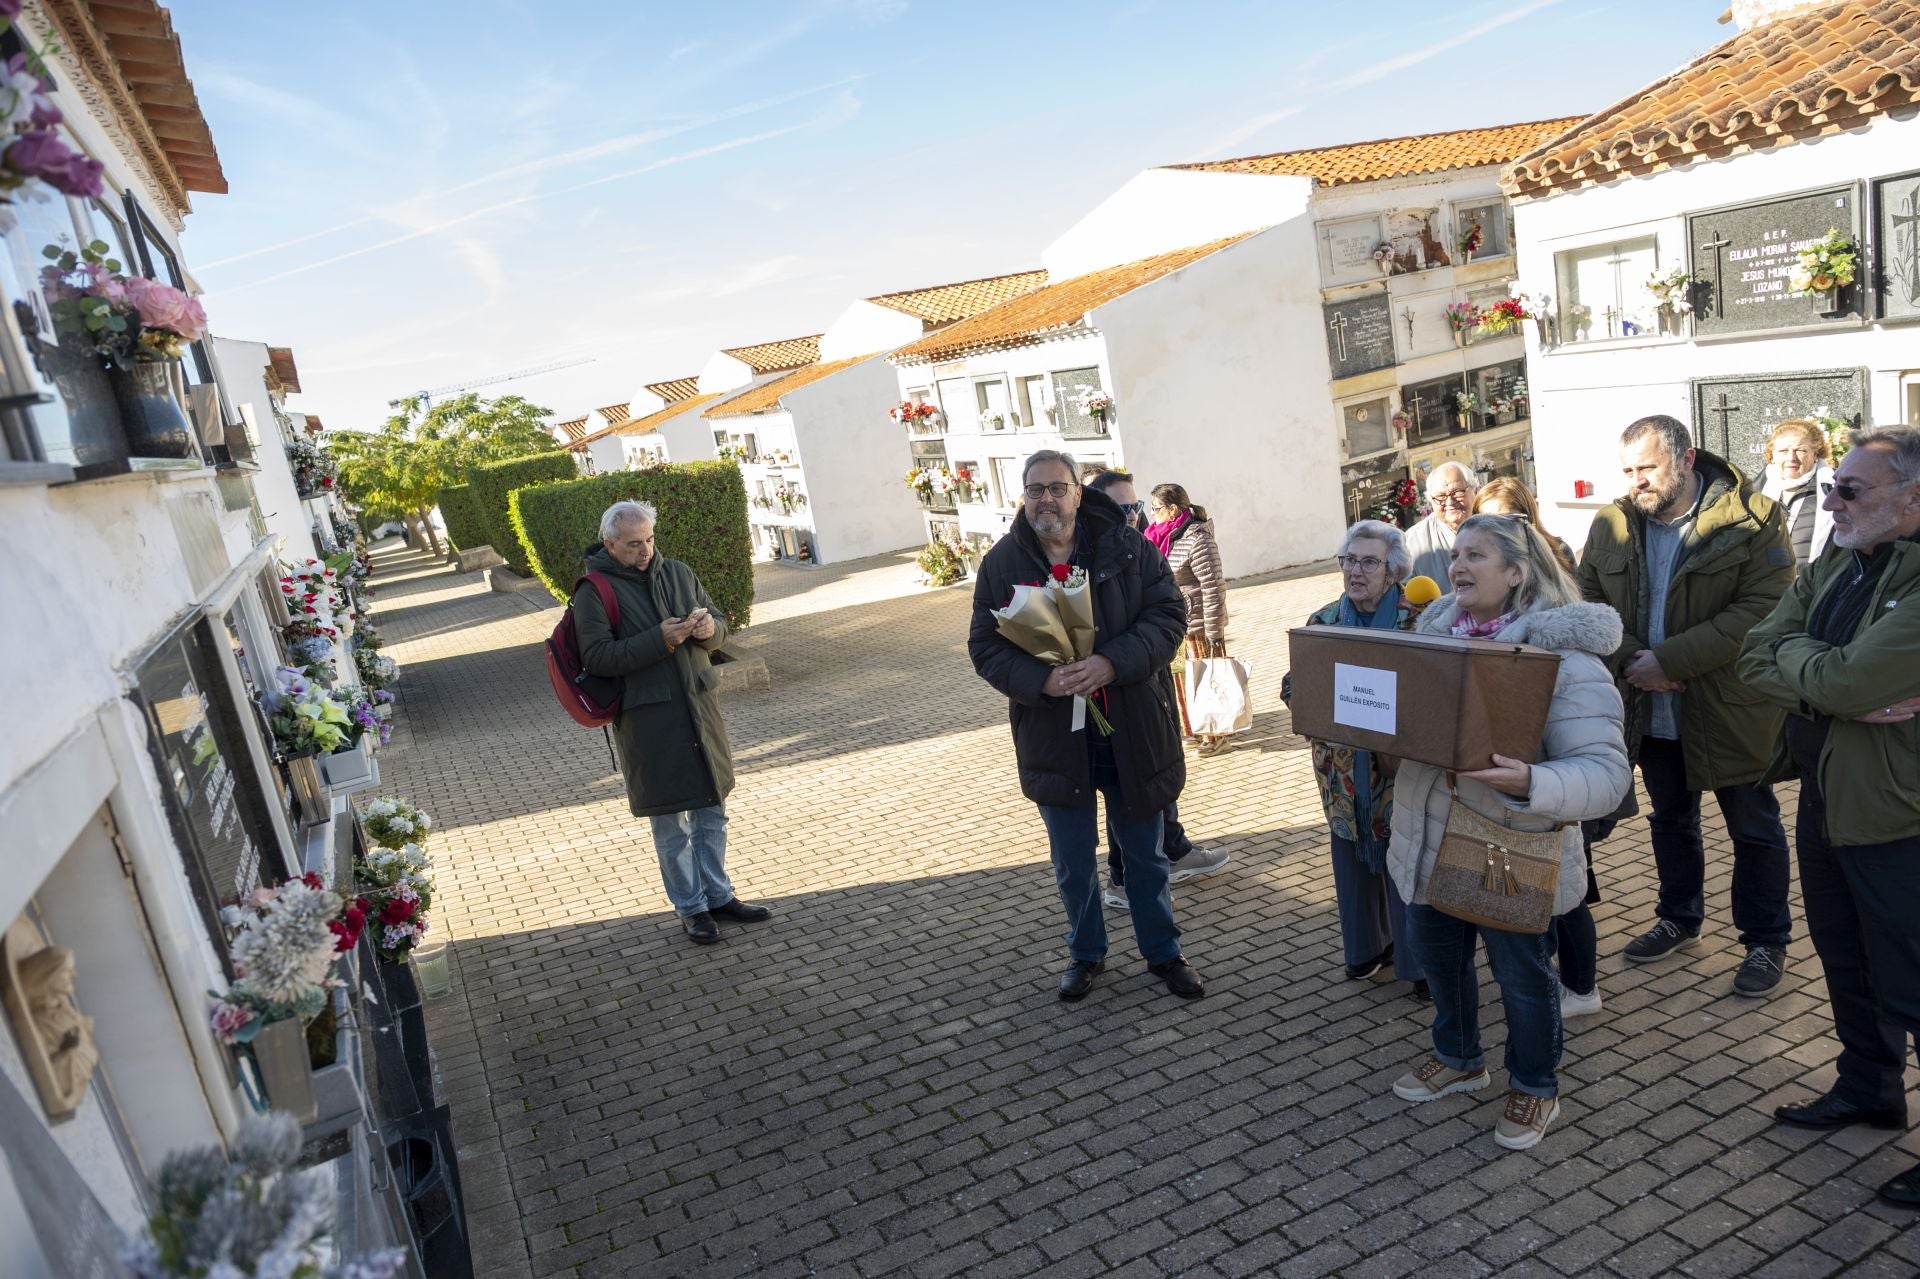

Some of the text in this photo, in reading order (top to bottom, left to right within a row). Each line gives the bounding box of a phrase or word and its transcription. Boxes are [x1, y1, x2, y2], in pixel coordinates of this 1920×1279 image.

[1730, 248, 1758, 261] EULALIA
[1740, 269, 1765, 282] JESUS
[1753, 280, 1783, 293] LOZANO
[1353, 686, 1375, 695] MANUEL
